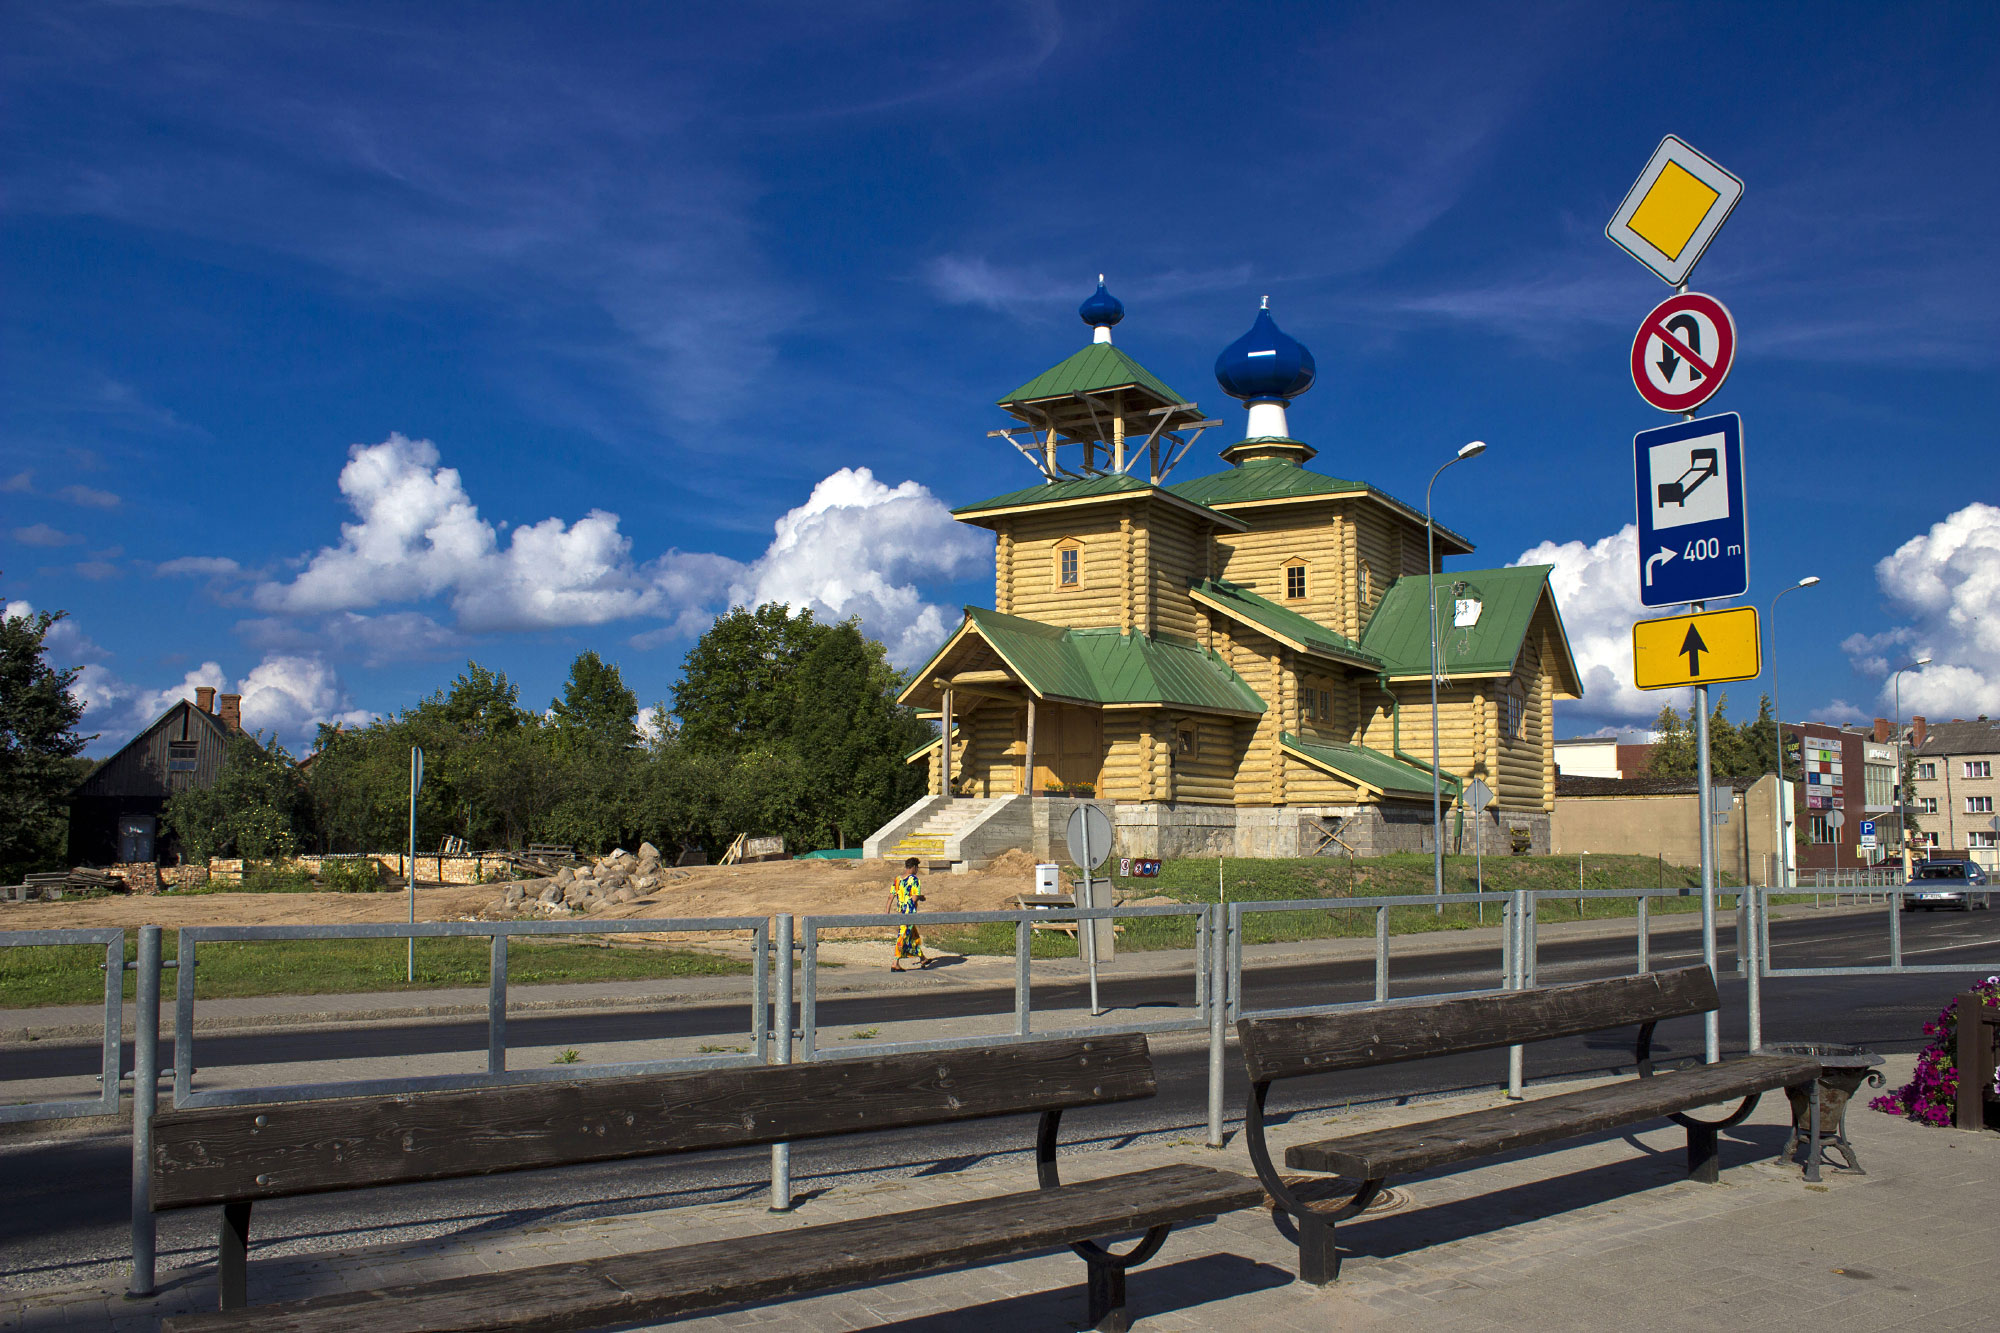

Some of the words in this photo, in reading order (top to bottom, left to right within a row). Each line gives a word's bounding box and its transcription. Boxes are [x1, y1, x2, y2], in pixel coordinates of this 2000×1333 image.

[1683, 538, 1719, 561] 400
[1727, 545, 1741, 556] m
[1863, 823, 1873, 834] P
